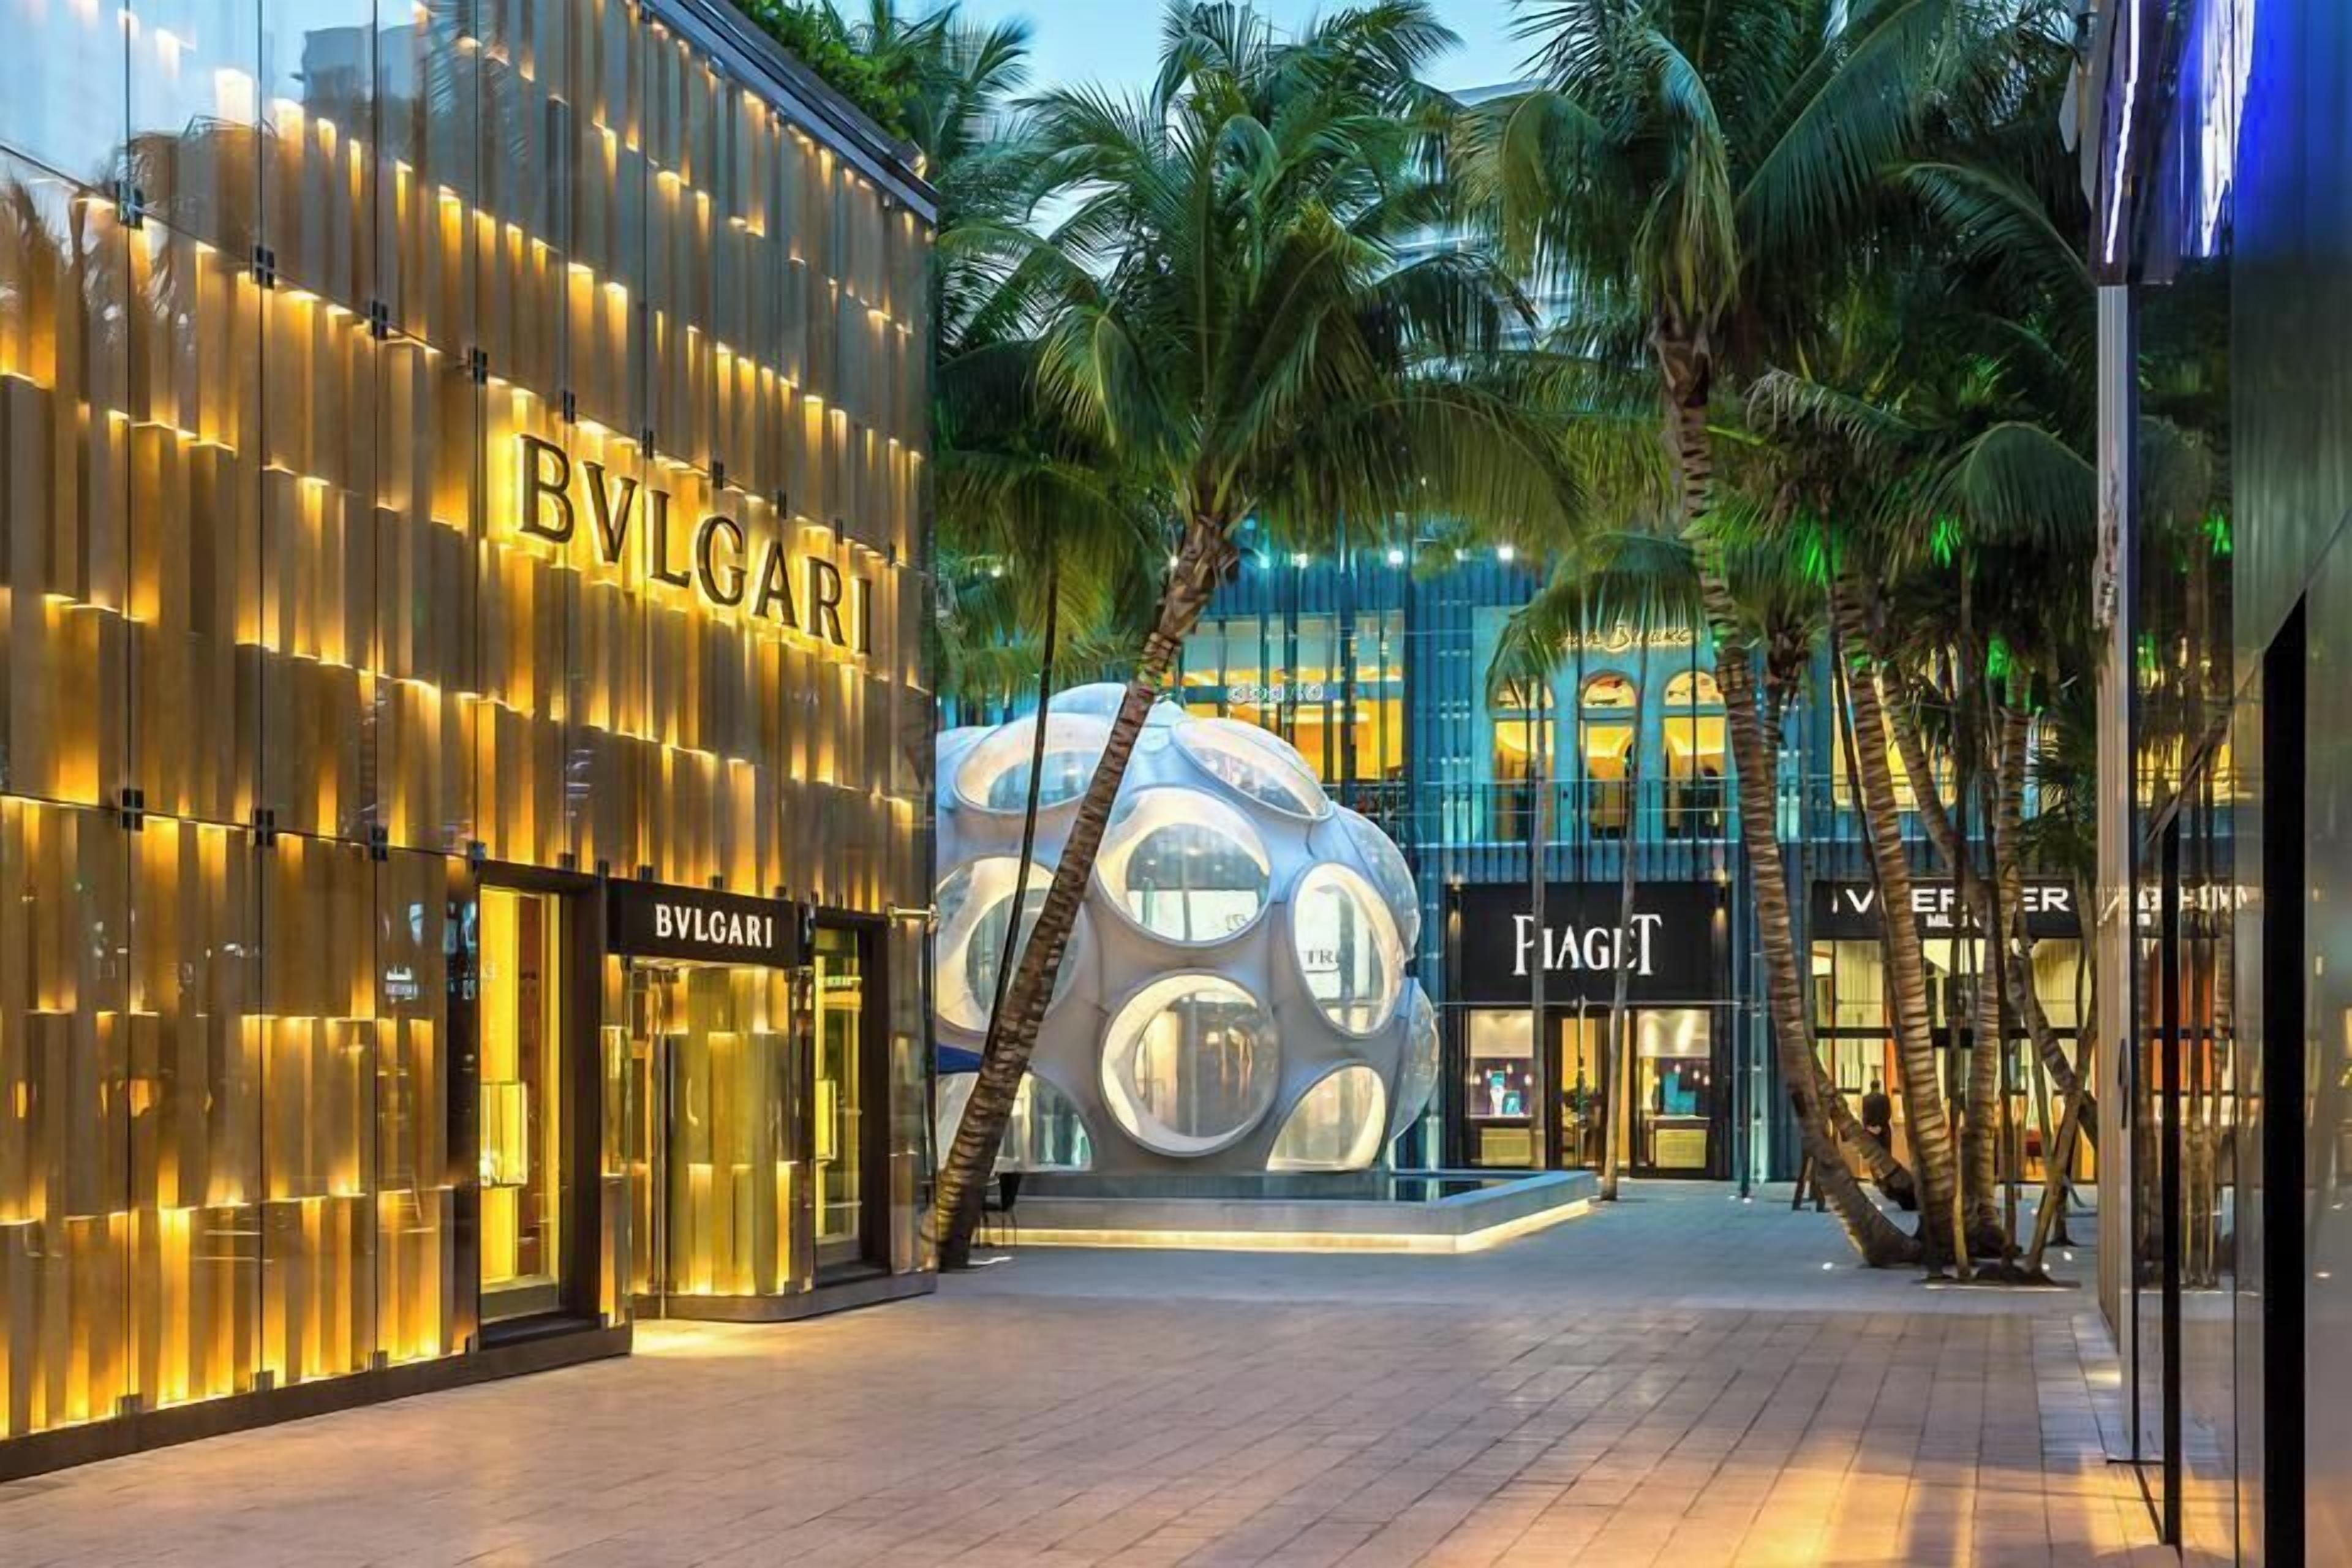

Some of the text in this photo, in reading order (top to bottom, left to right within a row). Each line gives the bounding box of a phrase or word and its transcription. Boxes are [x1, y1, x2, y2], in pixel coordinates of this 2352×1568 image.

[518, 432, 872, 656] BVLGARI
[655, 903, 772, 948] BVLGARI
[1512, 913, 1663, 976] PIAGET
